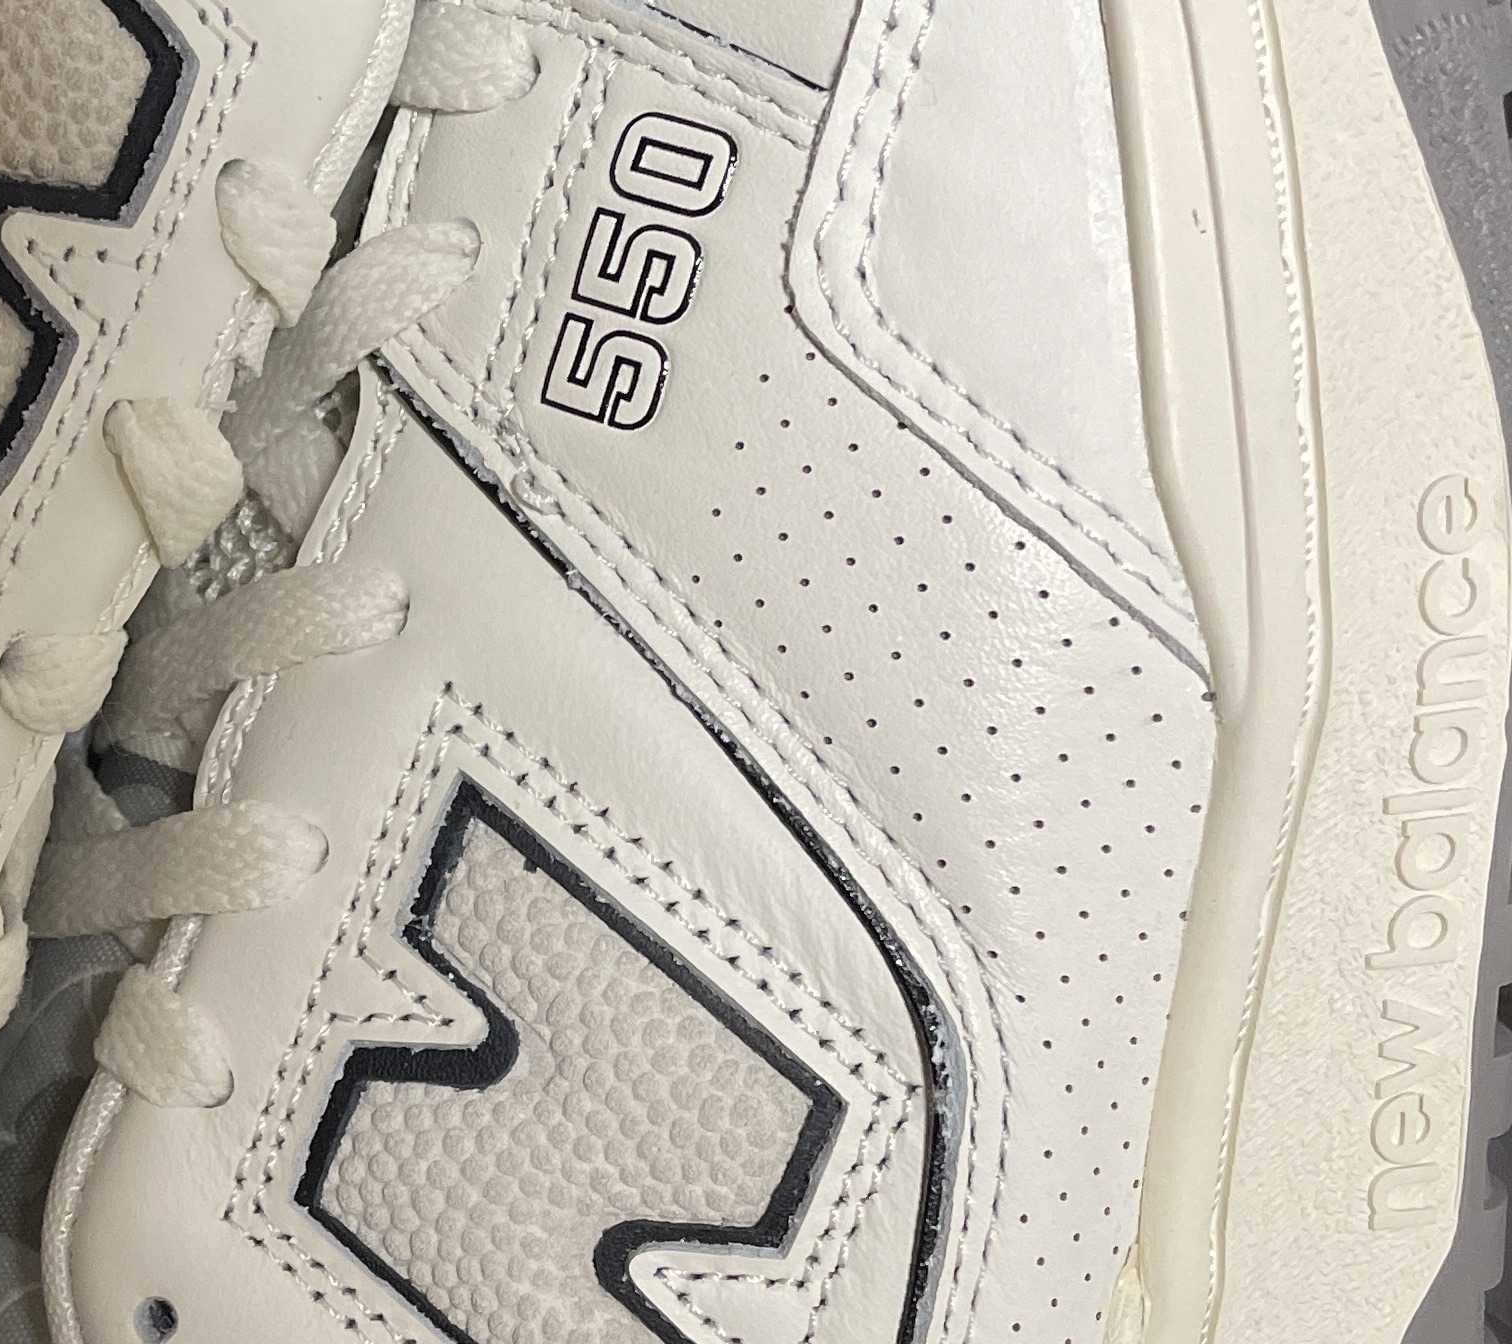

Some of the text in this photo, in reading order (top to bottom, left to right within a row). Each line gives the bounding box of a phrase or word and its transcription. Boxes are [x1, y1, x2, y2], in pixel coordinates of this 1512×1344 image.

[540, 112, 738, 430] 550
[1364, 472, 1488, 1233] new balance
